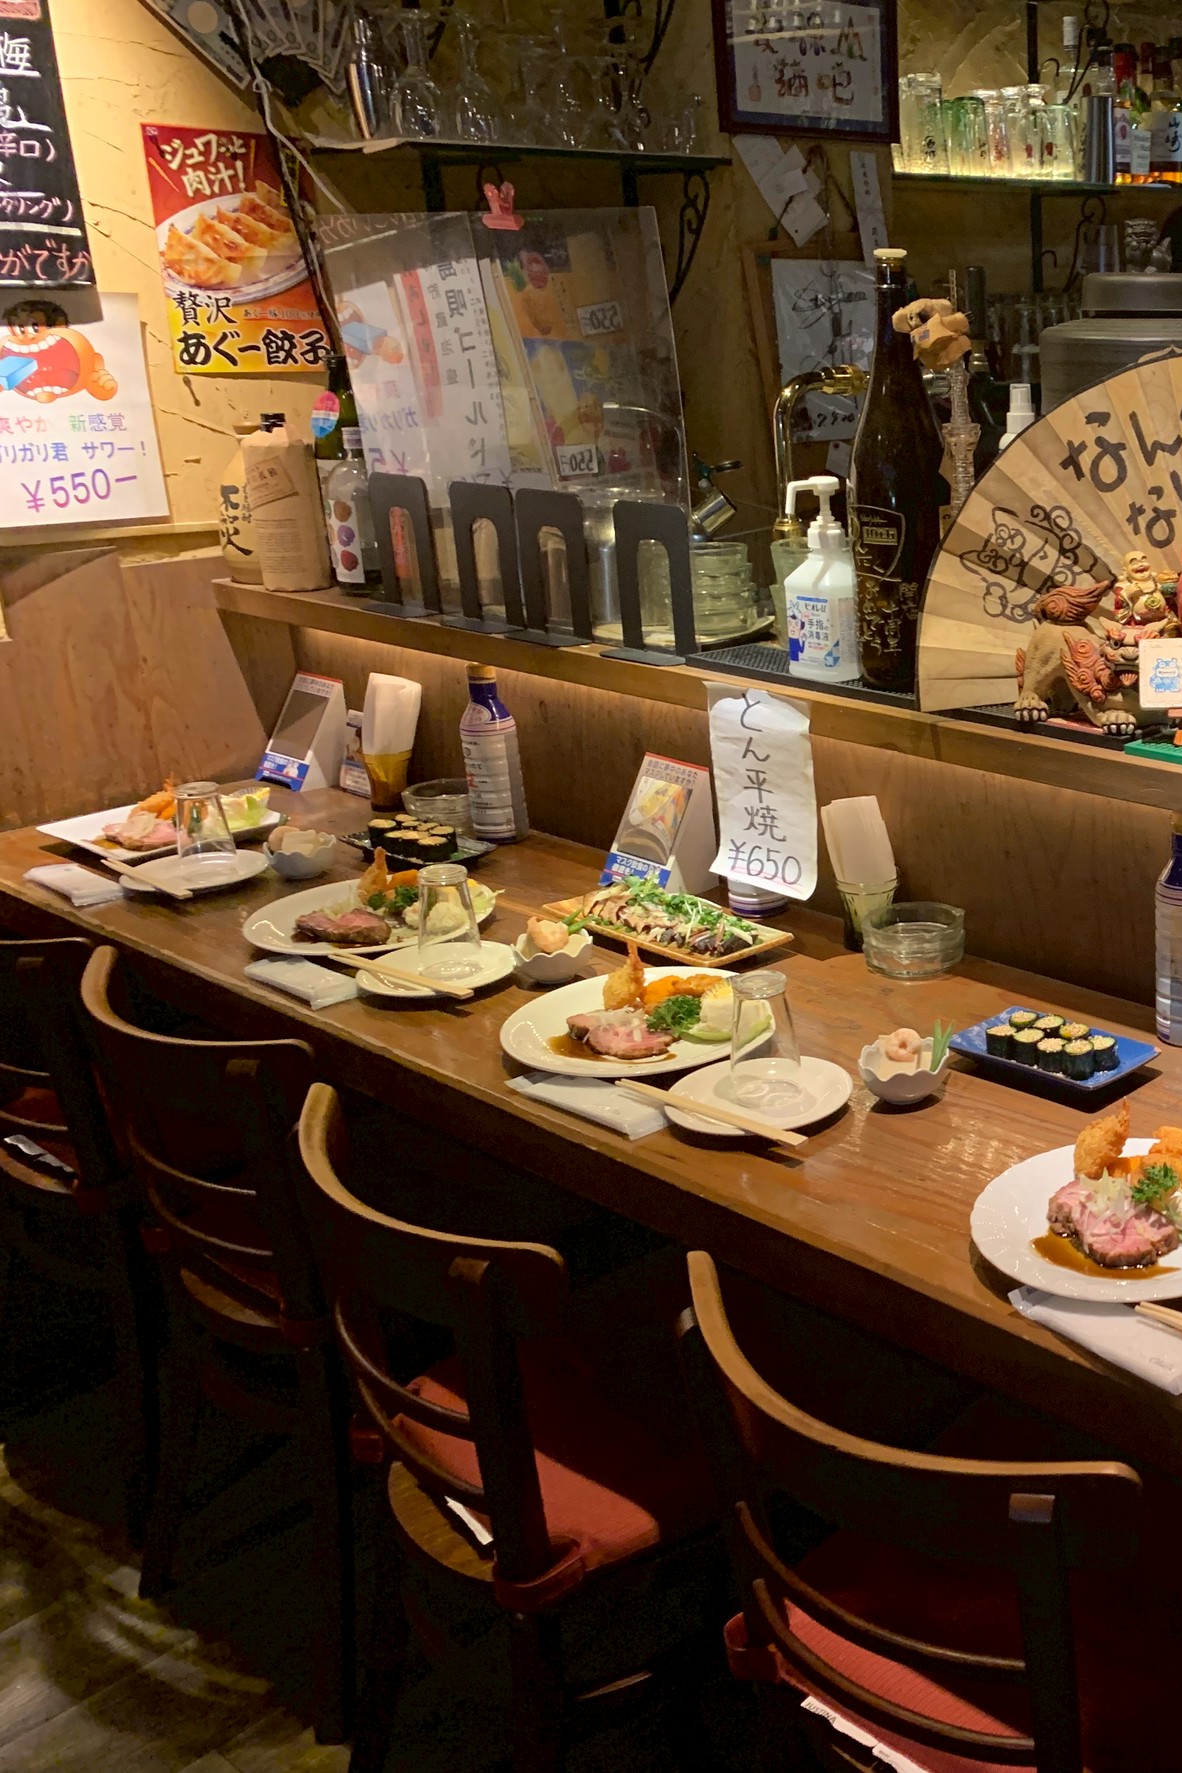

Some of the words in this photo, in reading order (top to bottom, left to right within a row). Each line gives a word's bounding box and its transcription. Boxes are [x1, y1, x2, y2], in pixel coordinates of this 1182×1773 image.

[0, 239, 91, 280] がですか
[172, 290, 238, 326] 贅沢
[176, 329, 331, 367] あぐー餃子
[68, 412, 128, 433] 新感覚
[739, 692, 788, 843] とん平焼
[727, 838, 803, 885] ¥650
